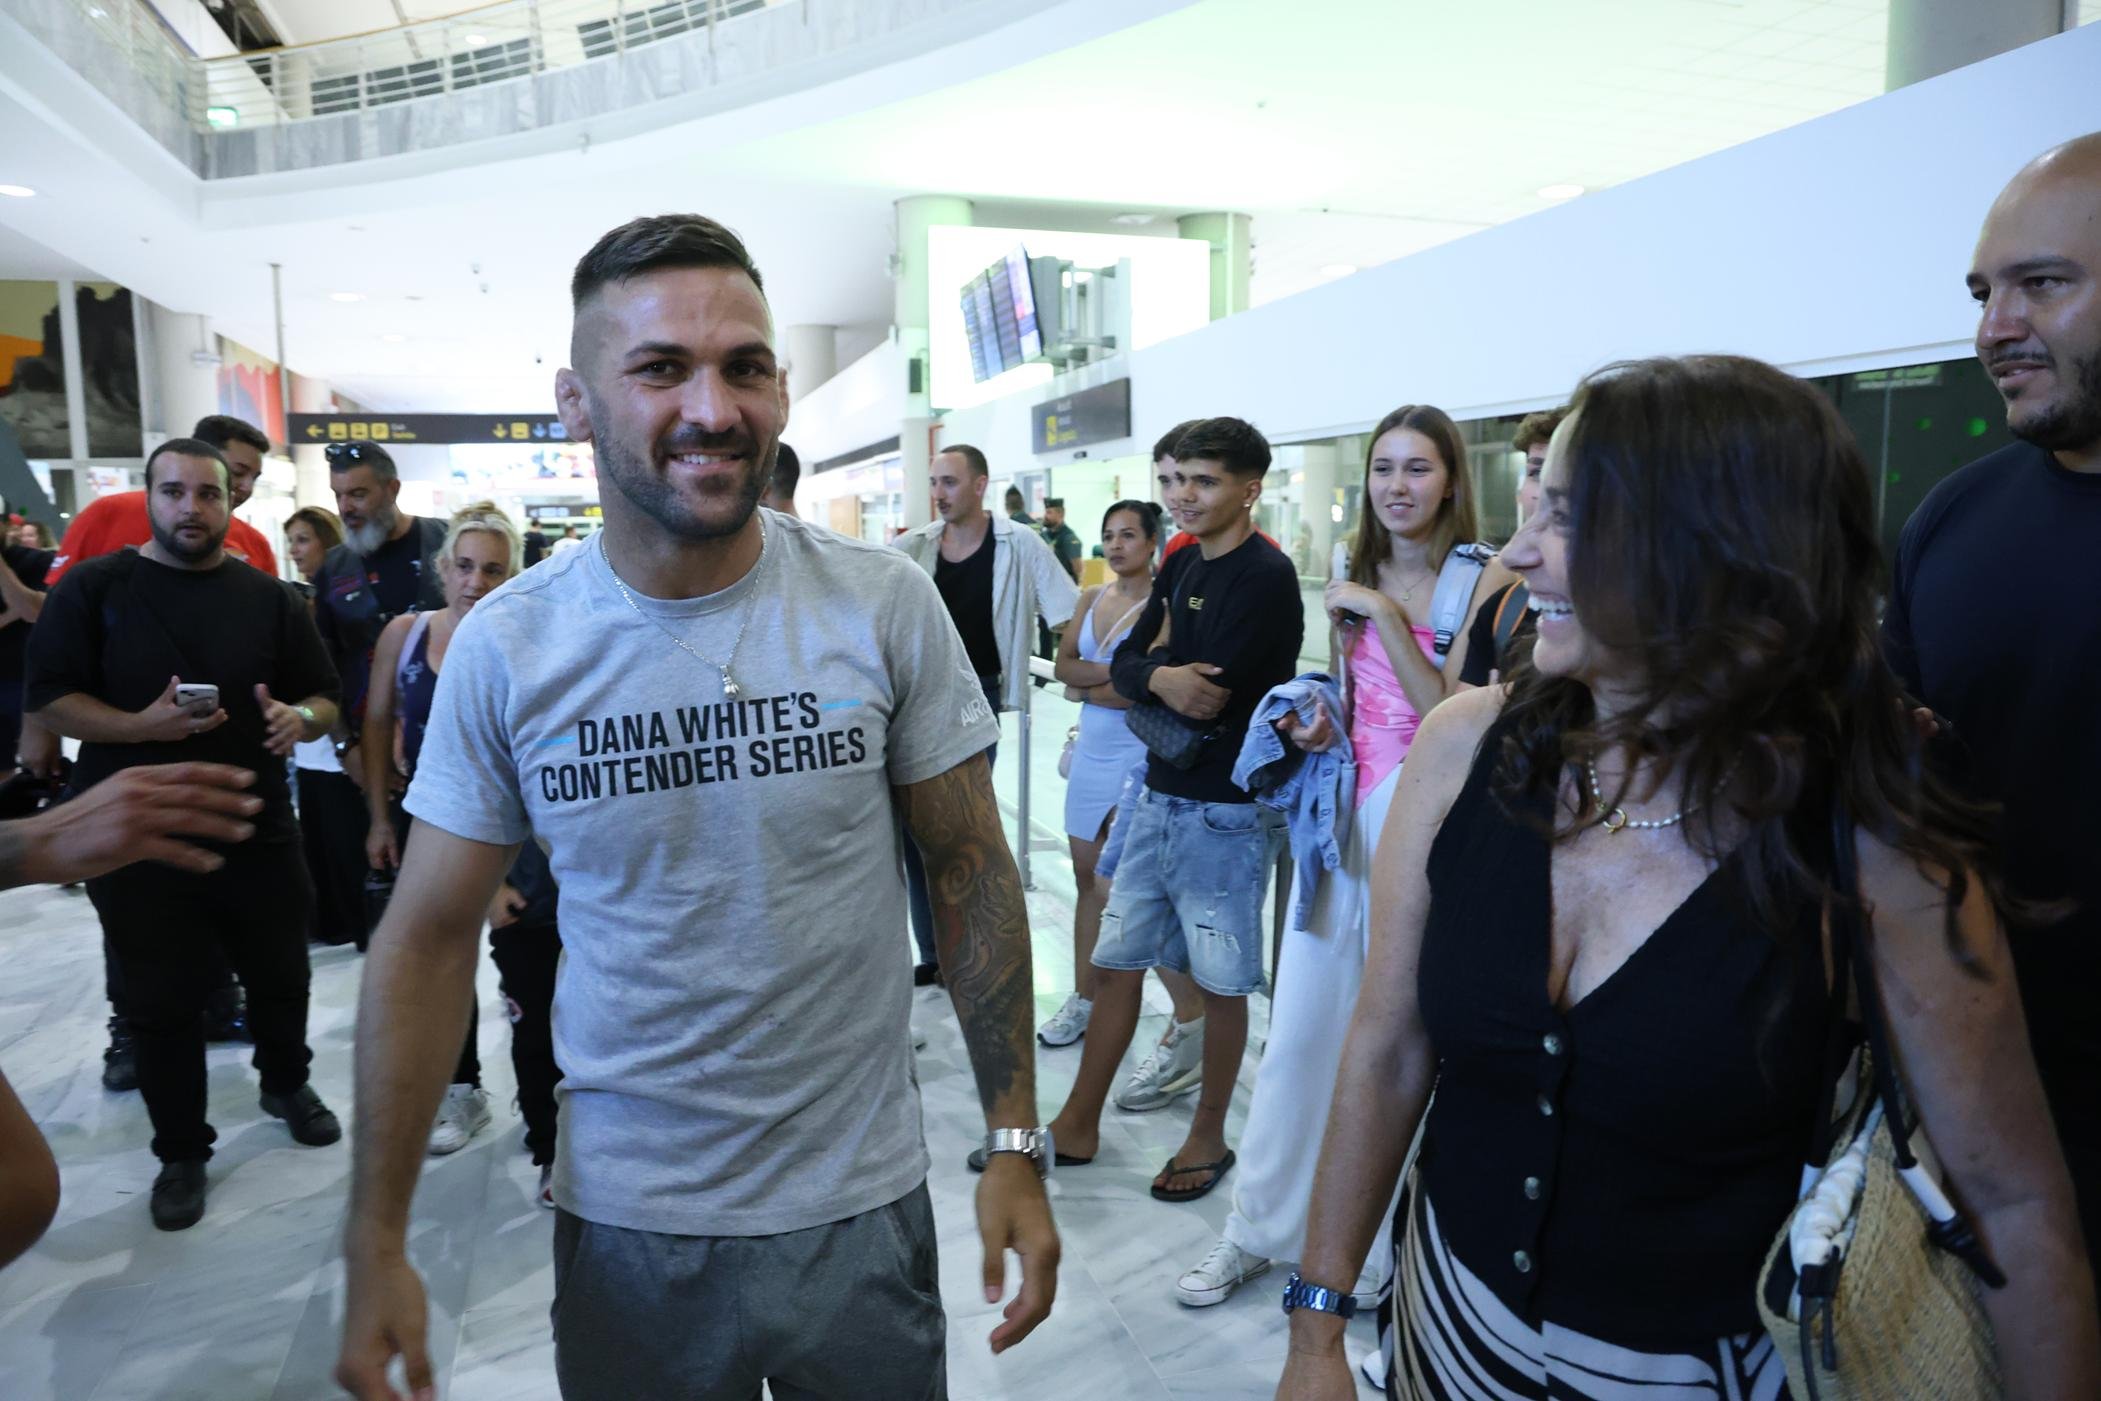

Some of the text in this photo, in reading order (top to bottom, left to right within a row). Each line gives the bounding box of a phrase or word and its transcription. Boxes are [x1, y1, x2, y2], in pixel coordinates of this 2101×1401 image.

[578, 692, 820, 757] DANA WHITE'S
[541, 727, 866, 802] CONTENDER SERIES
